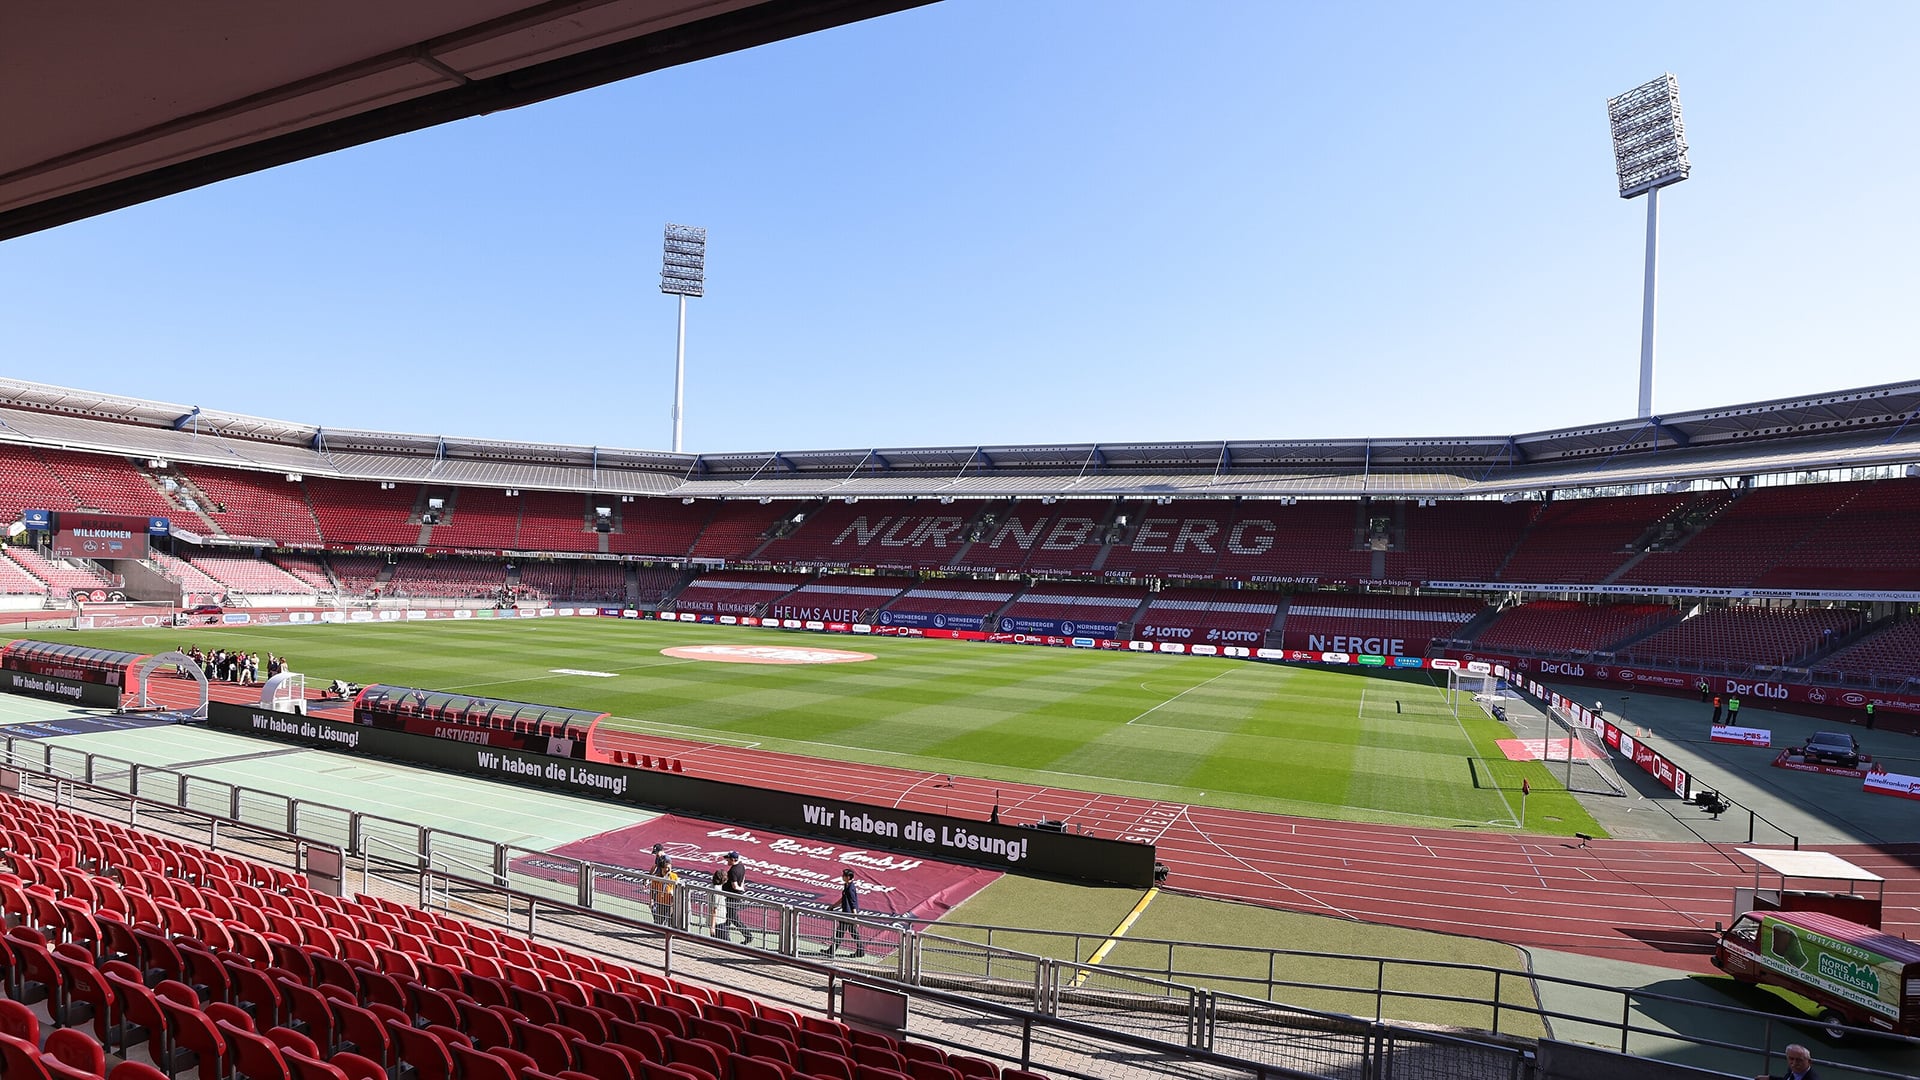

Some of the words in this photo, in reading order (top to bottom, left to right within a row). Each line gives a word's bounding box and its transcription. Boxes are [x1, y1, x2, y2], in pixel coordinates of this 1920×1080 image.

[73, 527, 132, 539] WILLKOMMEN
[354, 545, 426, 553] HIGHSPEED-INTERNET
[939, 565, 996, 573] GLASFASER-AUSBAU
[1251, 575, 1320, 584] BREITBAND-NETZE
[1359, 578, 1381, 586] bisping
[1388, 579, 1412, 587] bisping
[677, 600, 714, 610] KULMBACHER
[774, 605, 859, 623] HELMSAUER
[893, 613, 928, 621] NÜRNBERGER
[947, 616, 984, 624] NÜRNBERGER
[1016, 620, 1054, 628] NÜRNBERGER
[1076, 623, 1117, 631] NÜRNBERGER
[1156, 627, 1191, 638] LOTTO
[1221, 631, 1258, 641] LOTTO
[1541, 660, 1559, 673] Der
[1560, 663, 1585, 676] Club
[12, 675, 26, 687] Wir
[26, 676, 44, 690] haben
[44, 681, 56, 693] die
[56, 682, 83, 699] Lösung!
[1726, 679, 1753, 695] Der
[1754, 682, 1789, 699] Club
[1846, 695, 1863, 703] GP
[252, 714, 268, 729] Wir
[270, 716, 298, 734] haben
[300, 721, 317, 737] die
[318, 723, 360, 748] Lösung!
[434, 727, 490, 745] GASTVEREIN
[1785, 762, 1819, 772] KUMMICH
[1825, 767, 1861, 777] KUMMICH
[477, 751, 499, 770] Wir
[502, 754, 542, 777] haben
[545, 764, 567, 782] die
[570, 766, 627, 795] Lösung!
[1866, 777, 1909, 789] mittelfranken
[802, 804, 834, 829] Wir
[838, 807, 899, 839] haben
[903, 817, 936, 843] die
[940, 819, 1028, 861] Lösung!
[1125, 835, 1152, 843] 5
[838, 850, 923, 871] GmbH
[1821, 956, 1850, 974] NORIS
[1820, 965, 1874, 991] ROLLRASEN
[1762, 957, 1800, 977] SCHNELLES
[1828, 982, 1841, 994] für
[1842, 986, 1866, 1004] jeden
[1866, 998, 1898, 1018] Garten
